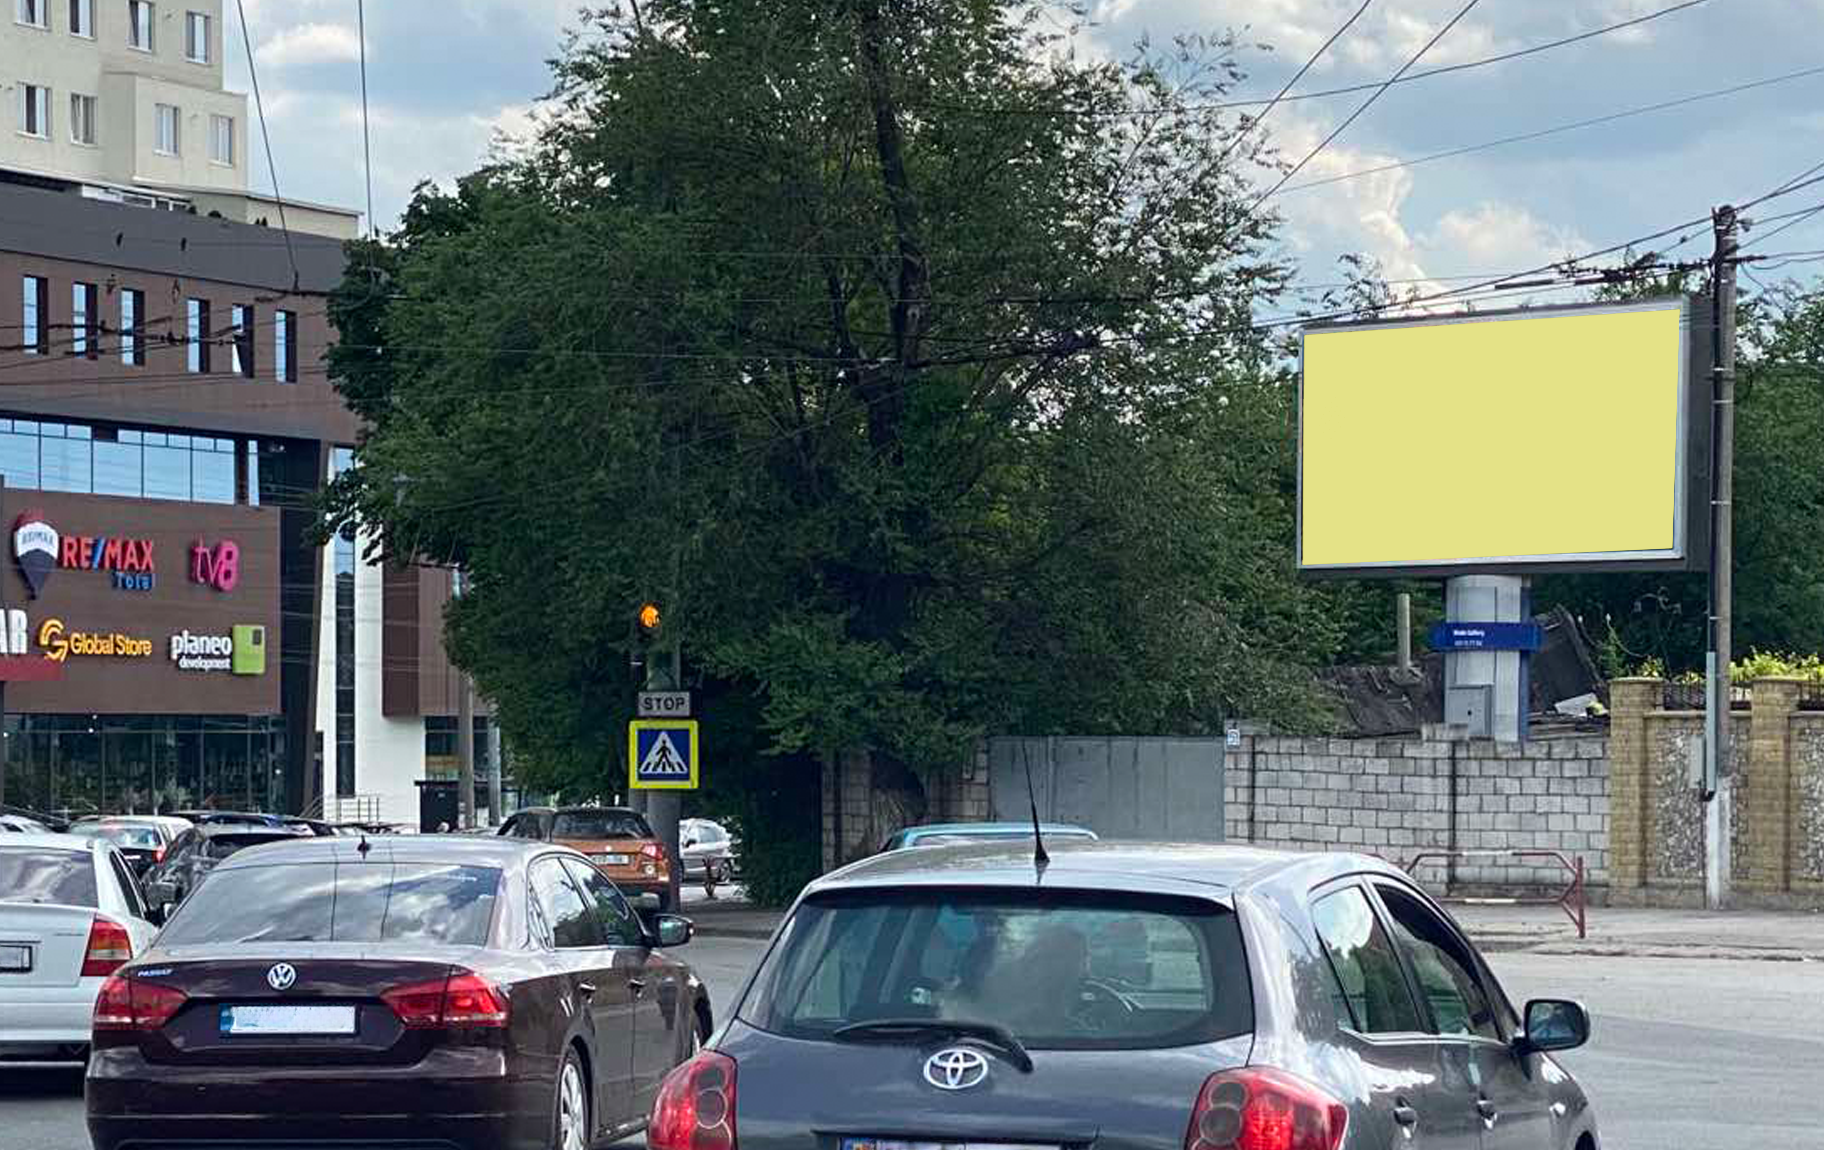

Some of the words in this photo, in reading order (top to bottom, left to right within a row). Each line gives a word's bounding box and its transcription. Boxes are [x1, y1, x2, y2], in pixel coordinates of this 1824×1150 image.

[63, 535, 154, 570] RE/MAX
[192, 538, 240, 591] tv8
[70, 632, 115, 655] Global
[116, 635, 152, 656] Store
[171, 629, 232, 660] planeo
[643, 697, 685, 710] STOP
